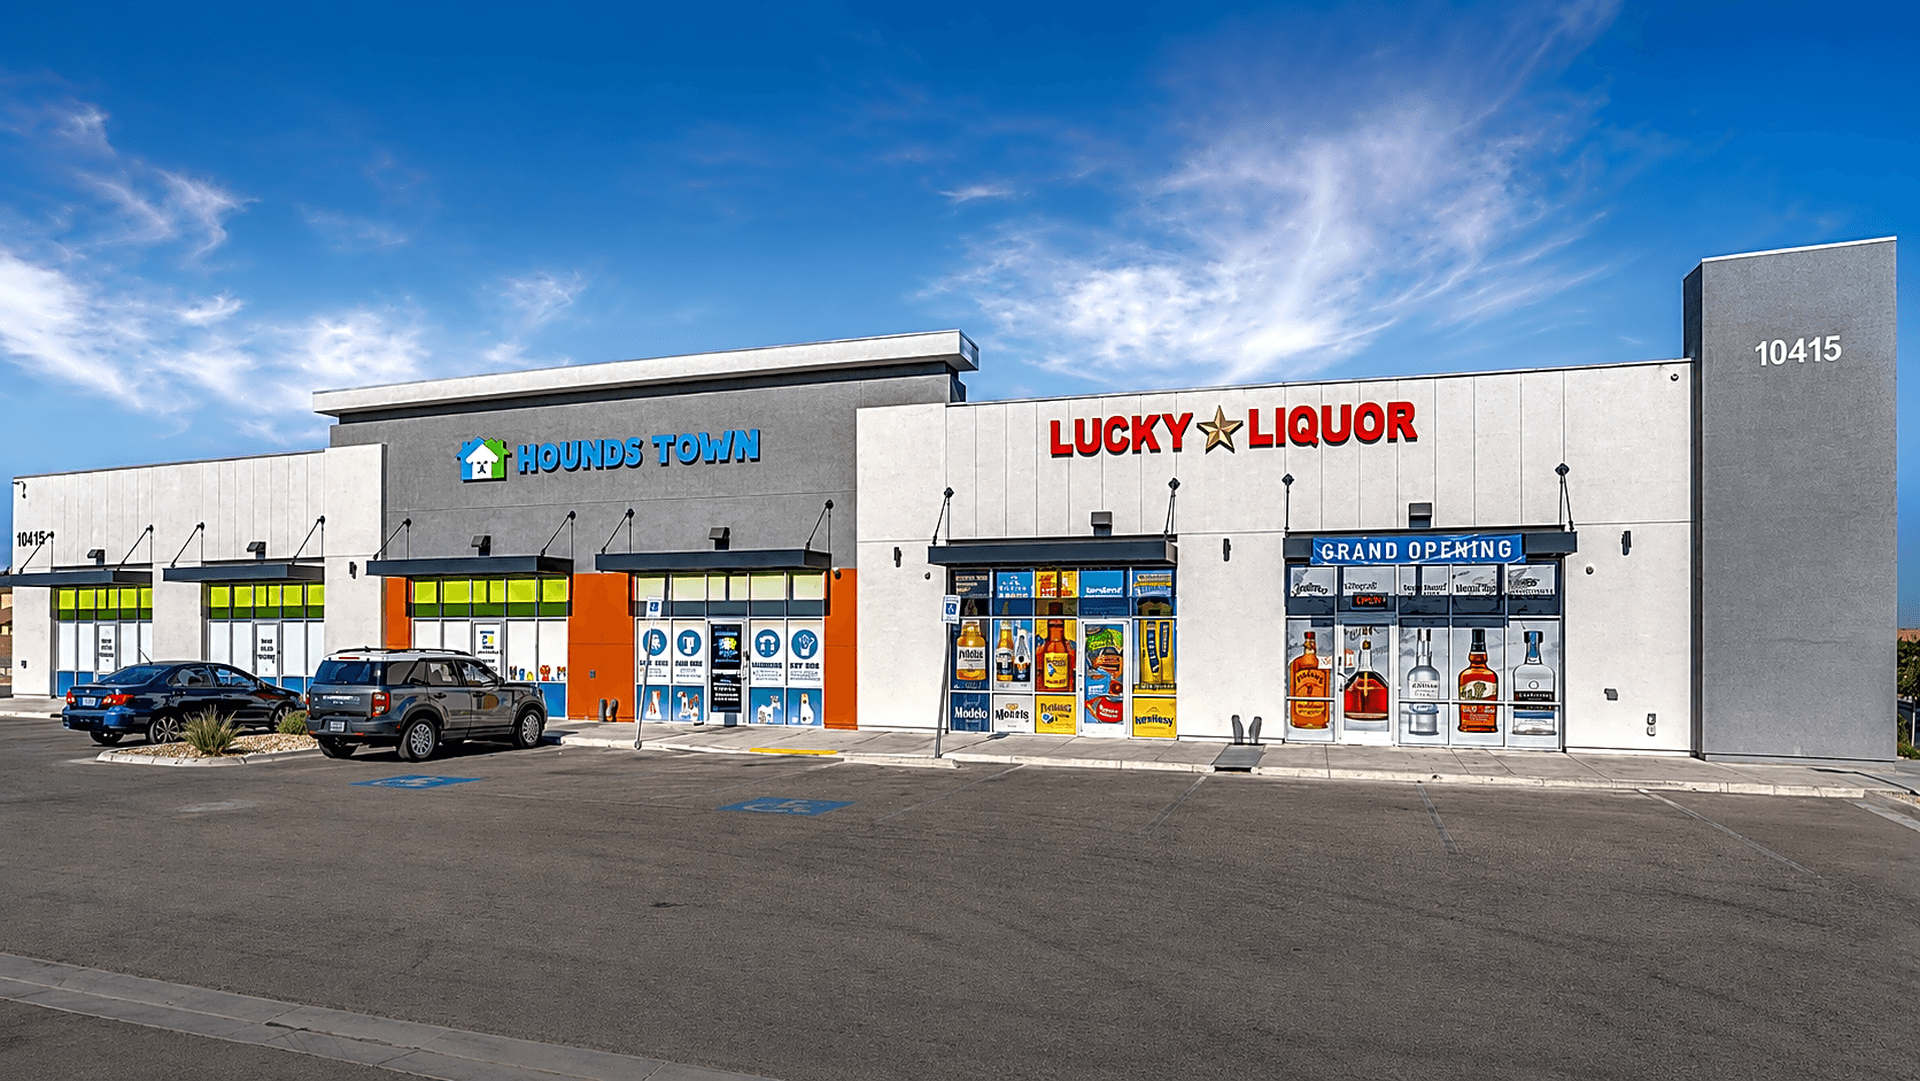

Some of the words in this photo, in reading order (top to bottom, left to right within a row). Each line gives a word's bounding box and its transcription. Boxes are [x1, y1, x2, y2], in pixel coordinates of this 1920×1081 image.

[1754, 334, 1843, 367] 10415
[1050, 412, 1193, 458] LUCKY
[1249, 401, 1418, 449] LIQUOR
[517, 436, 645, 475] HOUNDS
[651, 428, 761, 467] TOWN
[16, 530, 46, 548] 10415
[1321, 542, 1398, 560] GRAND
[1408, 539, 1512, 560] OPENING
